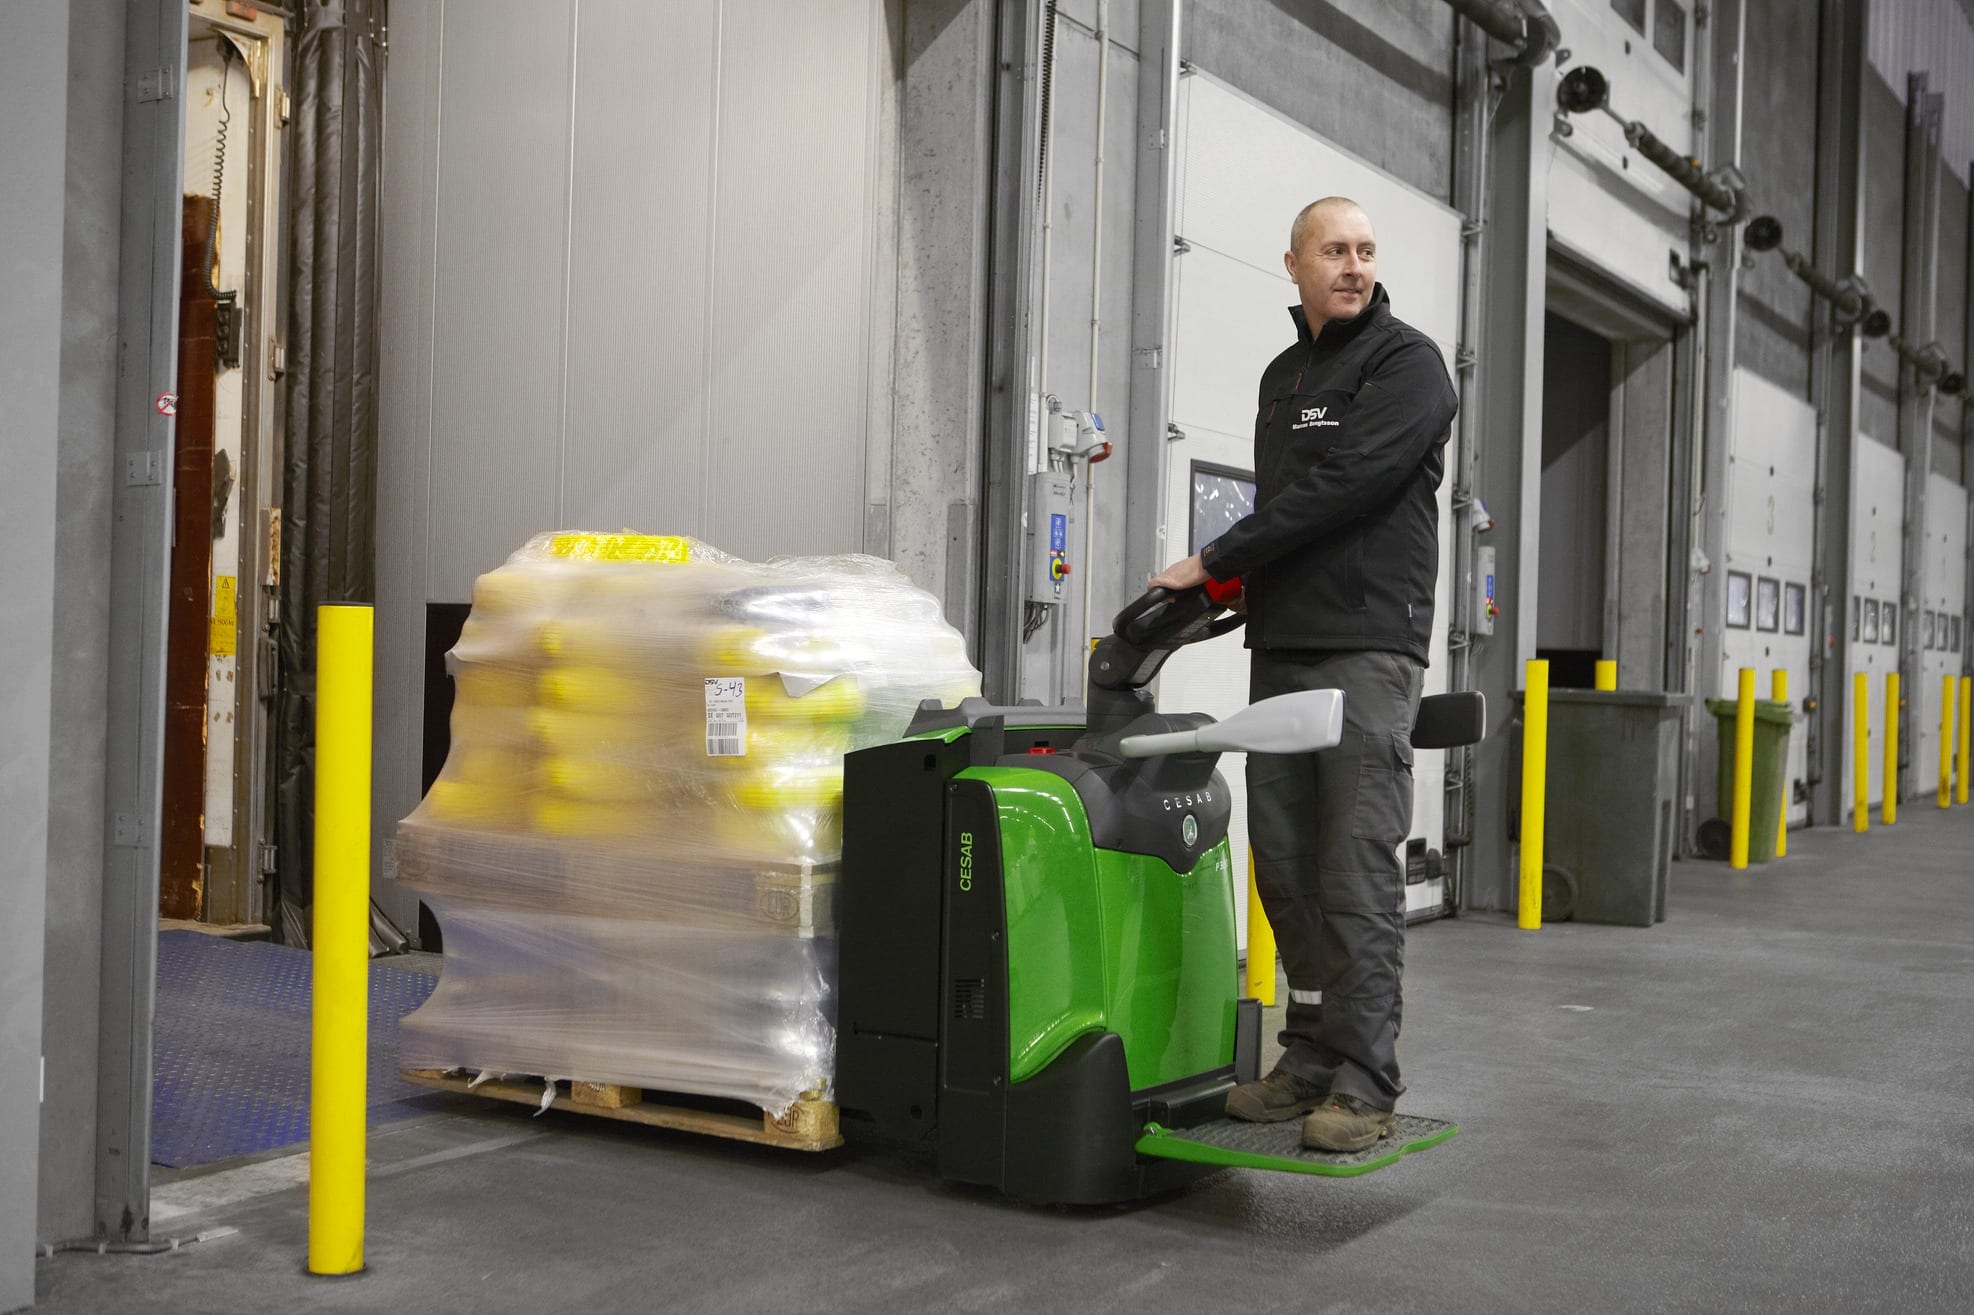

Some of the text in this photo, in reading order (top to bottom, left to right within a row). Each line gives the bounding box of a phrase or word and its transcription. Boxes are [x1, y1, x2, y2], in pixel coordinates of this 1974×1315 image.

[1301, 406, 1328, 421] DSV
[1766, 494, 1775, 536] 3
[1163, 792, 1212, 811] CESAB
[960, 832, 973, 892] CESAB
